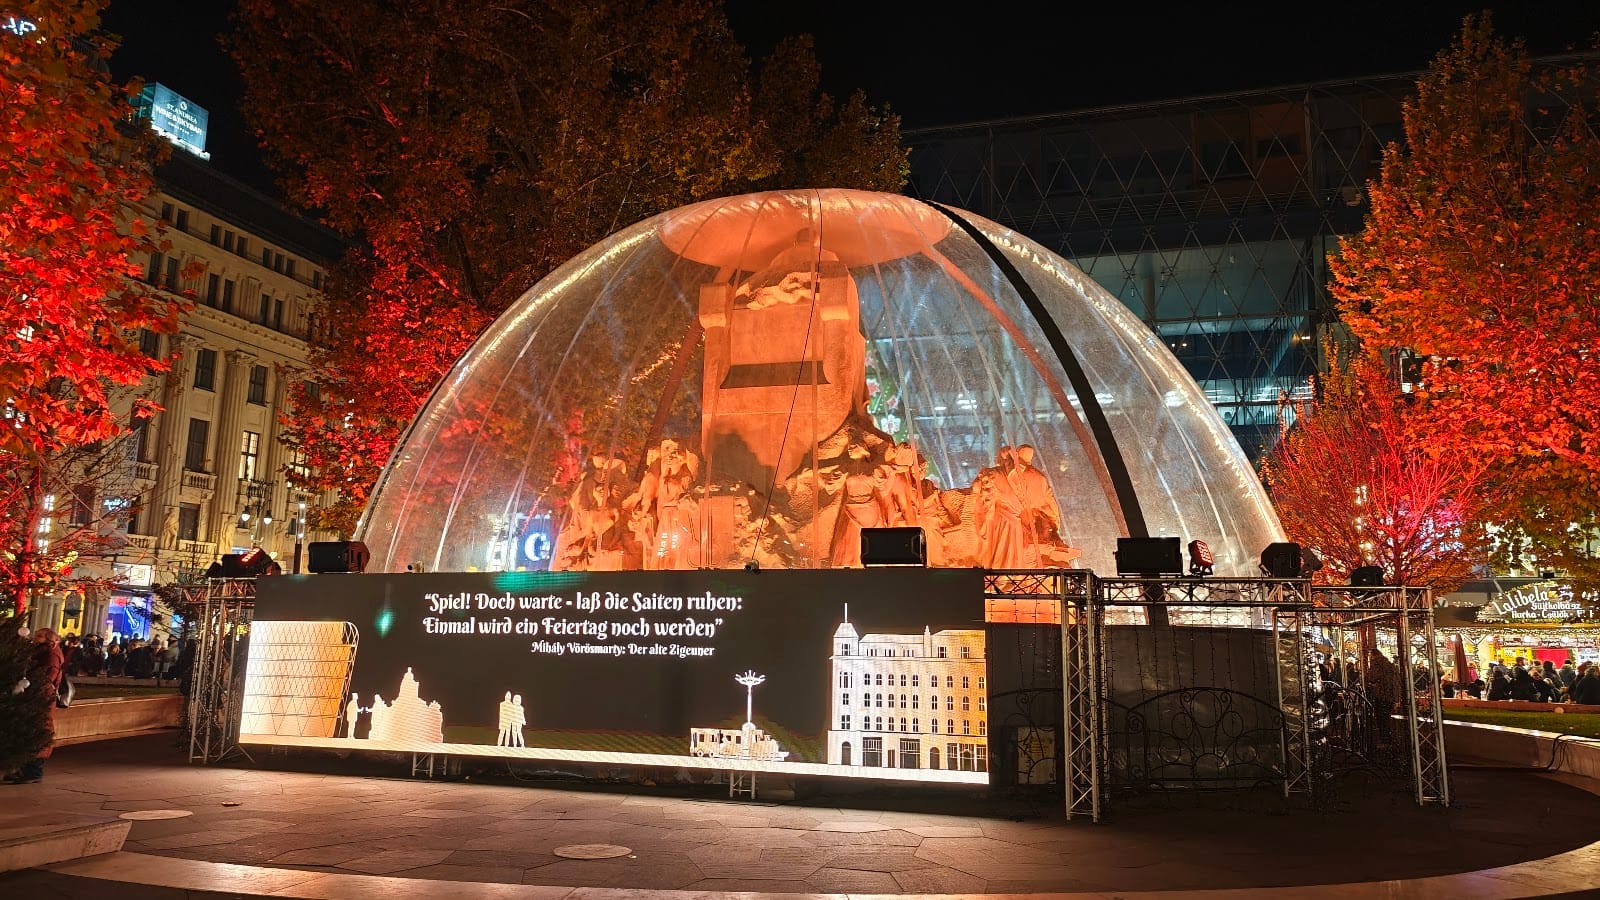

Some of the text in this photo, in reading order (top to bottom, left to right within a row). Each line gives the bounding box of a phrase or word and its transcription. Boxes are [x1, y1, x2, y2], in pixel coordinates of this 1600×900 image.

[424, 593, 471, 614] “Spiel!
[474, 592, 515, 611] Doch
[519, 594, 563, 610] warte
[576, 591, 601, 613] laß
[604, 592, 629, 610] die
[632, 592, 683, 612] Saiten
[687, 591, 743, 611] ruhen:
[1491, 585, 1550, 615] Lalibela
[1512, 609, 1537, 619] Hurka
[1541, 609, 1569, 619] Csülök
[422, 617, 723, 640] Einmal wird ein Feiertag noch werden”
[531, 640, 716, 658] Mihály Vörösmarty: Der alte Zigeuner
